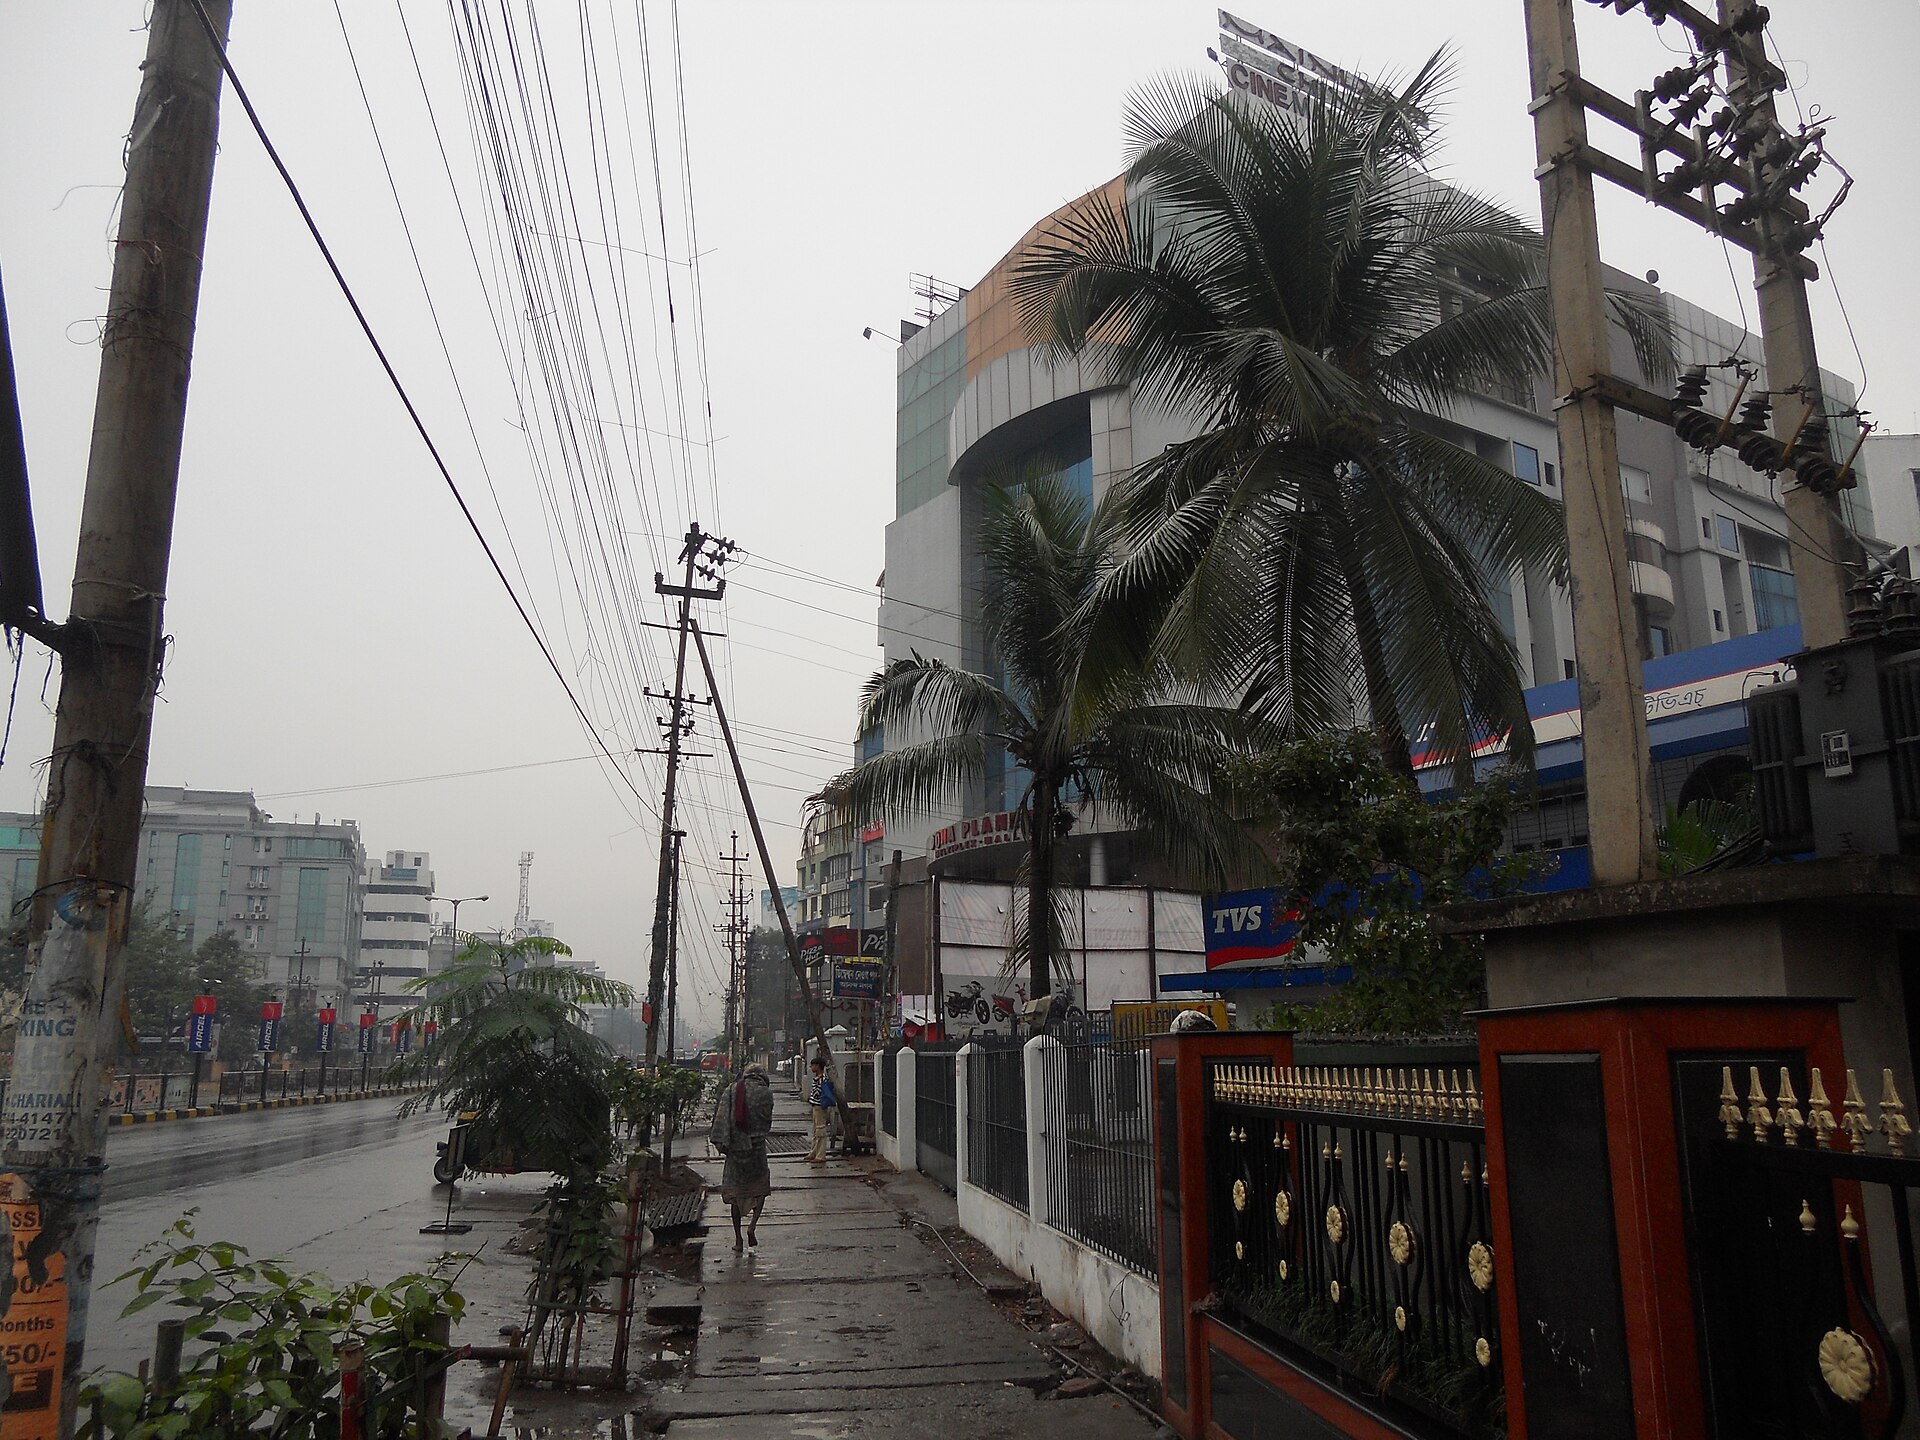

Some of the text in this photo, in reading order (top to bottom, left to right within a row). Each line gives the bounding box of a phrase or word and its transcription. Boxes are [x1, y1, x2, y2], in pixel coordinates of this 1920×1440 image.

[1212, 905, 1262, 933] TVS
[800, 945, 823, 960] Pizza
[804, 951, 820, 964] Hut
[195, 1014, 206, 1049] AIRCEL
[263, 1020, 273, 1050] AIRCEL
[321, 1023, 330, 1051] AIRCEL
[6, 1210, 37, 1228] SS
[0, 1341, 57, 1365] 50/-
